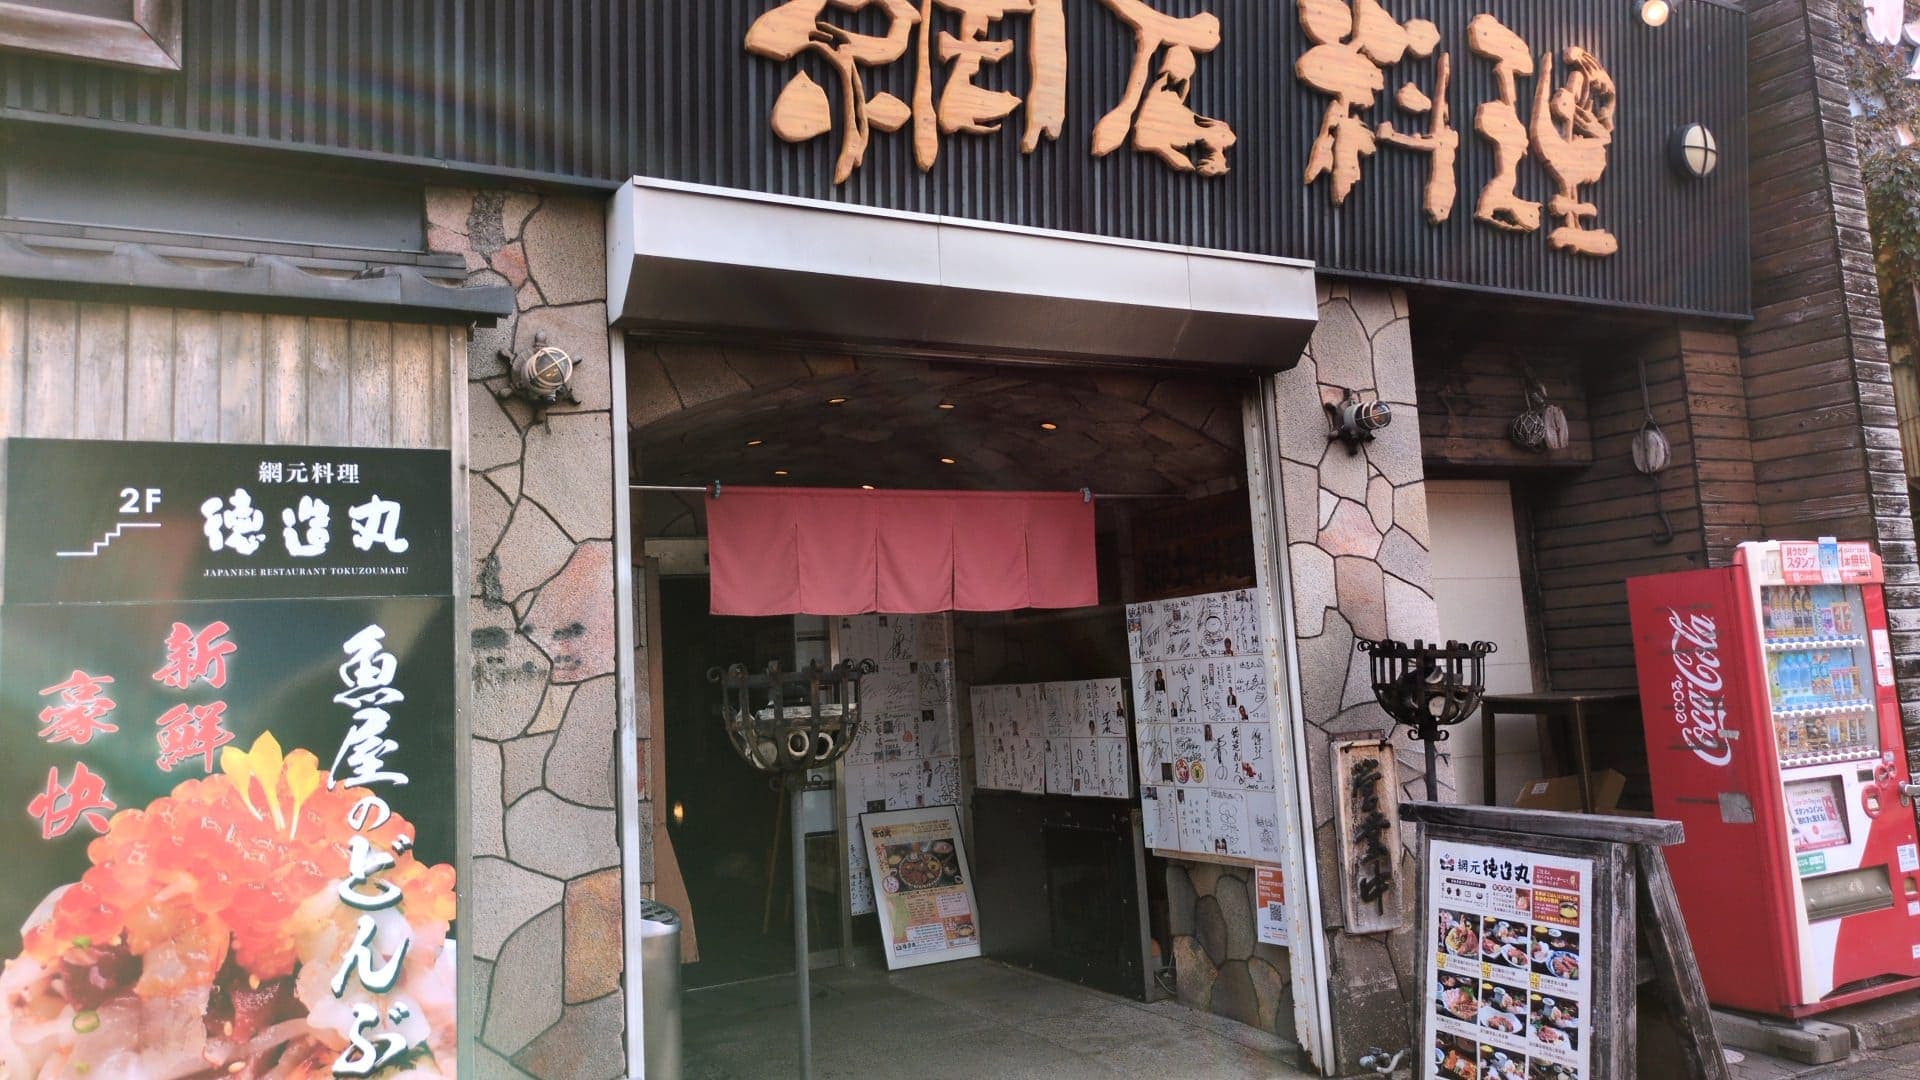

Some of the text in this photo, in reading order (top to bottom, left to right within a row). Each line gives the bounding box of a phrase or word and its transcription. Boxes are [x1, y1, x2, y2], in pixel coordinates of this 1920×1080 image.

[258, 461, 360, 484] 網元料理
[118, 487, 162, 513] 2F
[201, 488, 409, 557] 徳造丸
[203, 566, 409, 577] JAPANESE RESTAURANT TOKUZOUMARU
[1787, 557, 1816, 569] スタンプ
[152, 620, 238, 774] 新鮮
[27, 669, 120, 840] 豪快
